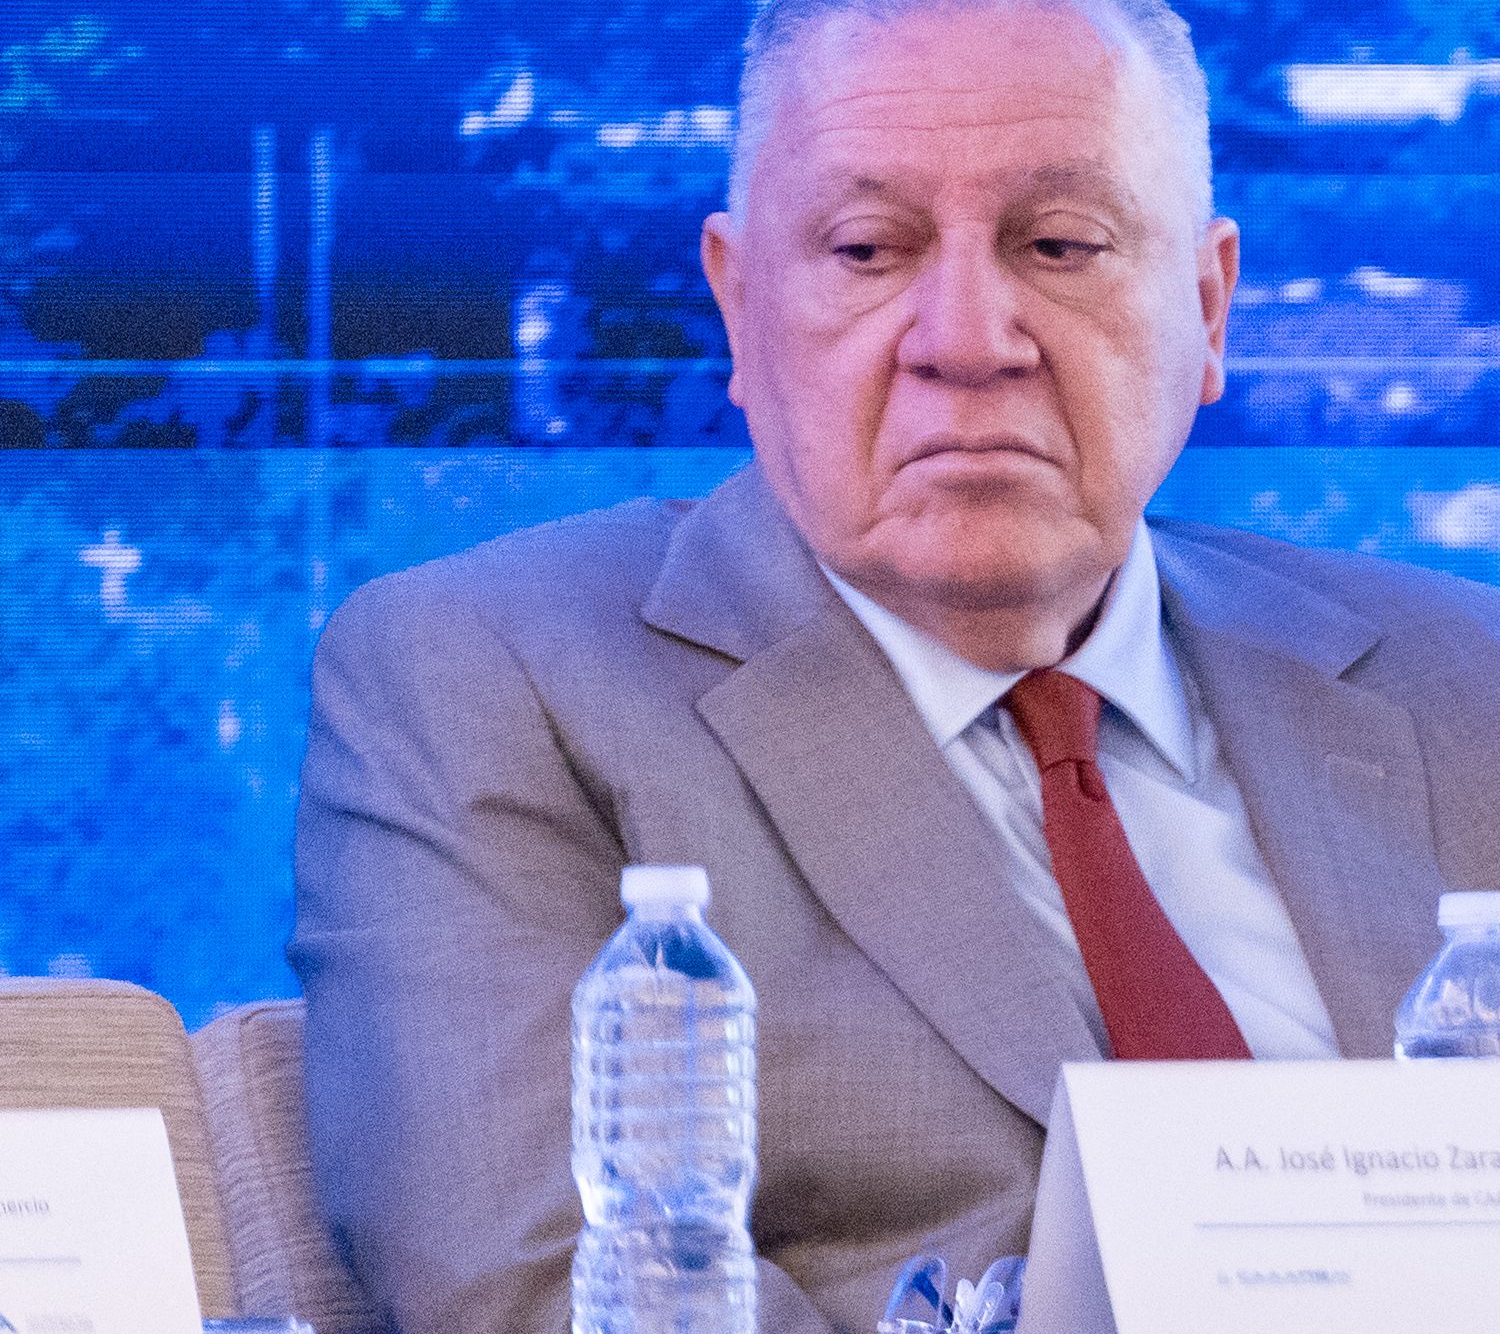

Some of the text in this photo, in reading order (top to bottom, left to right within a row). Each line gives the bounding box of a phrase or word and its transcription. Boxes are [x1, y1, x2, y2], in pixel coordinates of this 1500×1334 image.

[1216, 1145, 1270, 1171] A.A.
[1279, 1143, 1336, 1171] José
[1342, 1143, 1440, 1177] Ignacio
[1362, 1191, 1447, 1208] Presidente
[1451, 1191, 1471, 1208] de
